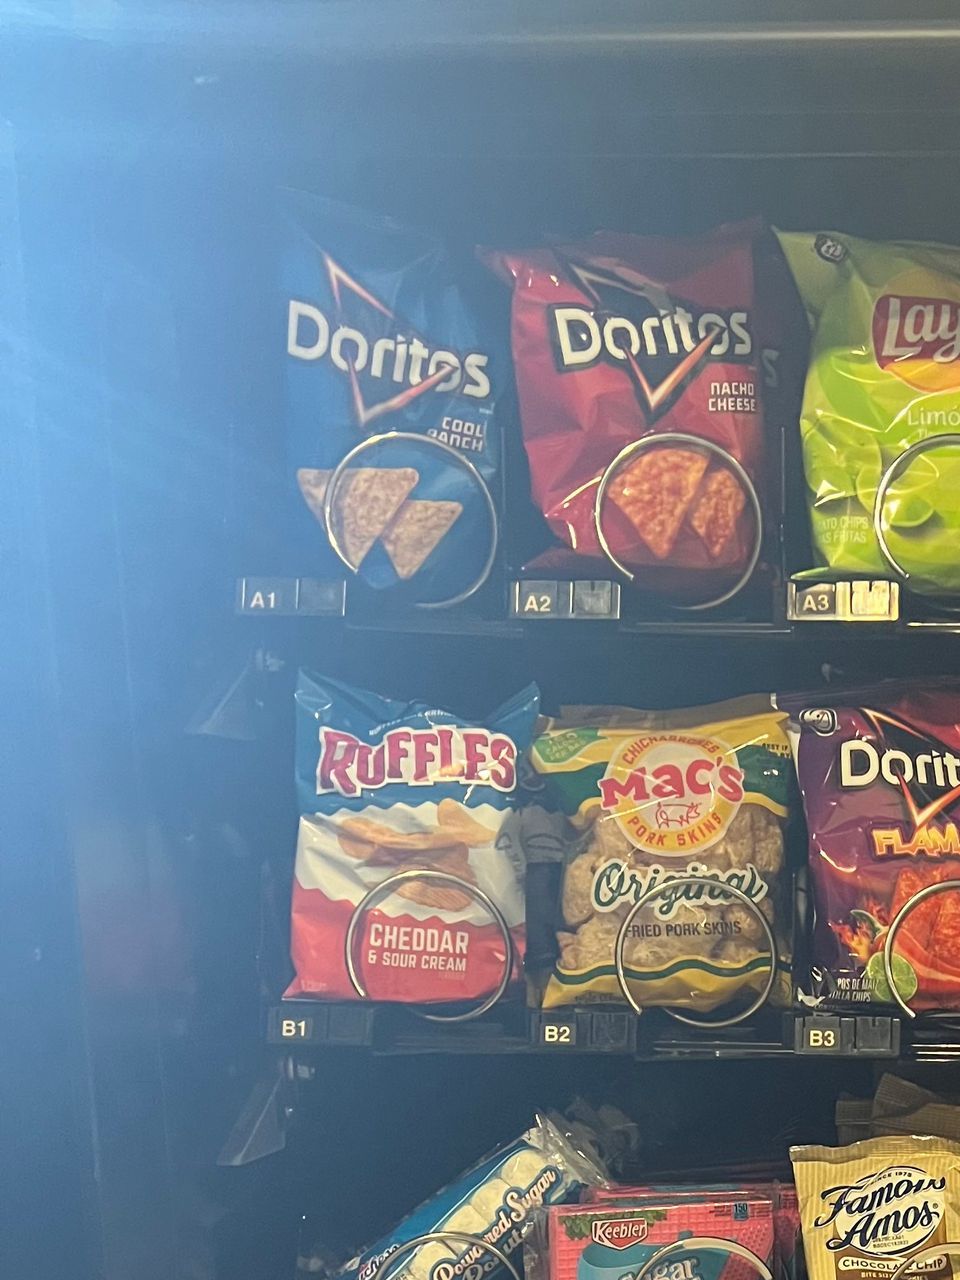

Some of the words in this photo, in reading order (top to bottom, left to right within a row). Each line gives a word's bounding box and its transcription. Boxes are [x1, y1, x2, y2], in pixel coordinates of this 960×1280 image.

[554, 306, 751, 367] Doritos
[287, 300, 491, 398] Doritos
[711, 382, 755, 396] NACHO
[708, 397, 757, 412] CHEESE
[442, 417, 482, 437] COOL
[251, 593, 276, 608] A1
[524, 595, 551, 612] A2
[803, 595, 830, 612] A3
[320, 729, 515, 795] RUFFLES
[600, 756, 743, 808] Mac's
[628, 816, 666, 846] PORK
[677, 812, 722, 846] SKINS
[626, 924, 661, 938] FRIED
[665, 923, 701, 938] PORK
[703, 922, 741, 936] SKINS
[369, 925, 469, 954] CHEDDAR
[368, 951, 377, 965] &
[382, 953, 418, 968] SOUR
[422, 957, 466, 972] CREAM
[282, 1022, 306, 1037] B1
[545, 1027, 571, 1042] B2
[809, 1031, 835, 1047] B3
[734, 1204, 748, 1212] 150
[594, 1222, 646, 1244] Keebler
[826, 1200, 940, 1250] Amos
